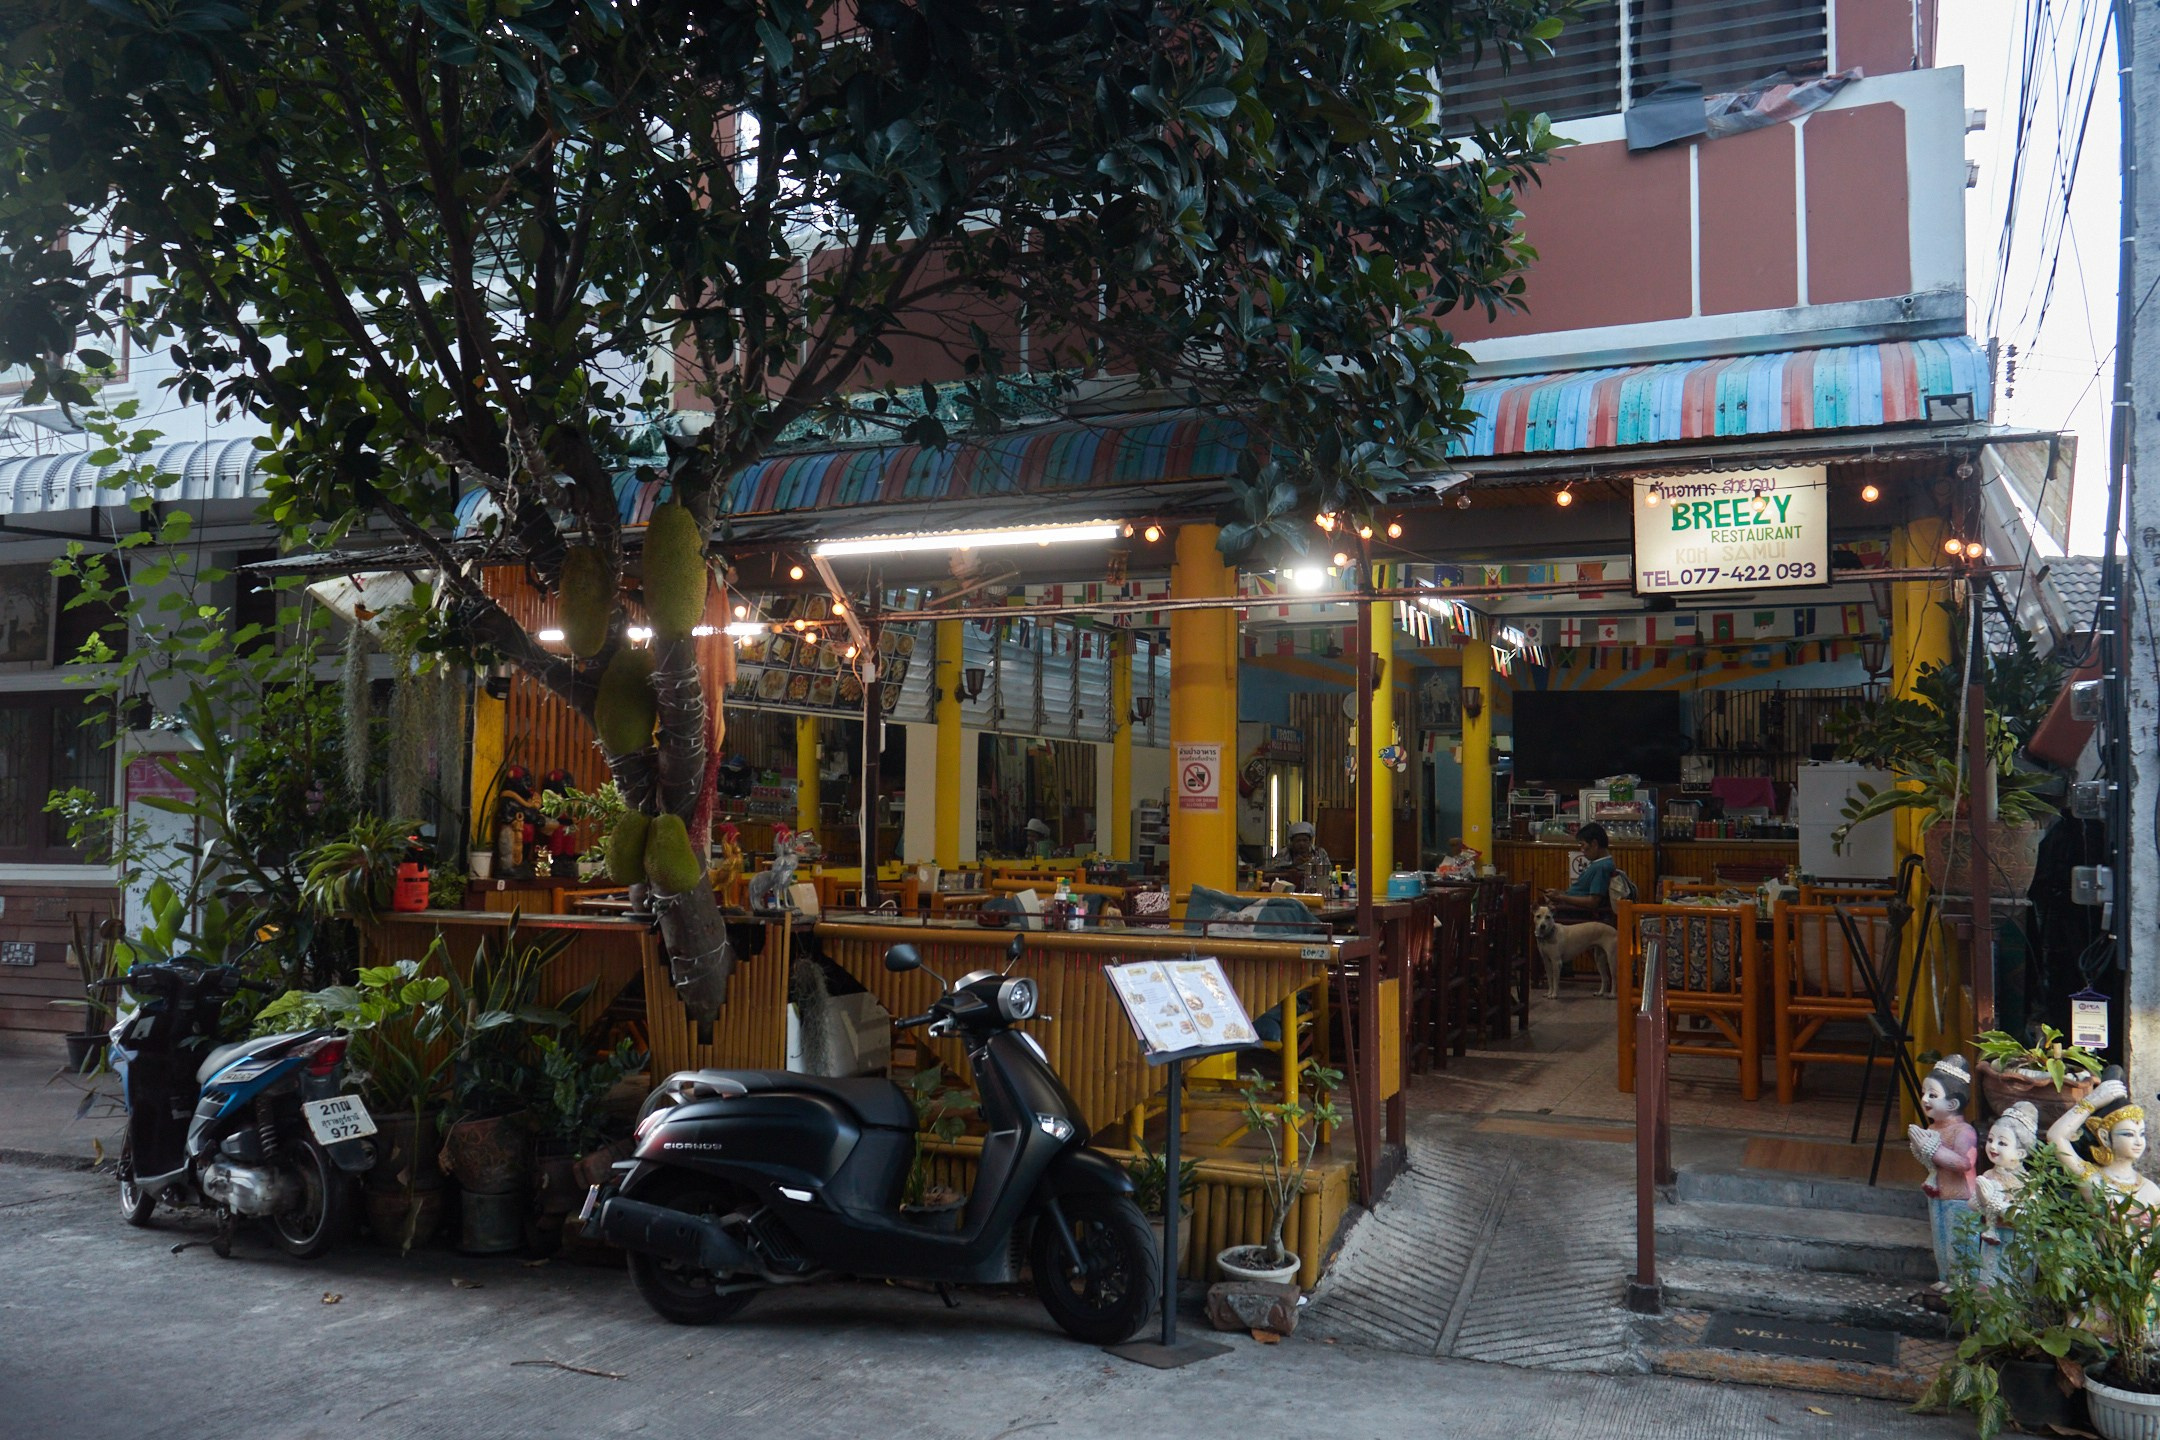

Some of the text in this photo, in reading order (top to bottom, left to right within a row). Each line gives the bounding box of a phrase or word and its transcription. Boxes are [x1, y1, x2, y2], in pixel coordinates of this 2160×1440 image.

[1671, 494, 1792, 531] BREEZY
[1711, 525, 1802, 543] RESTAURANT
[1675, 541, 1787, 565] KOH SAMUI
[1776, 562, 1817, 580] 093
[331, 1125, 361, 1138] 972
